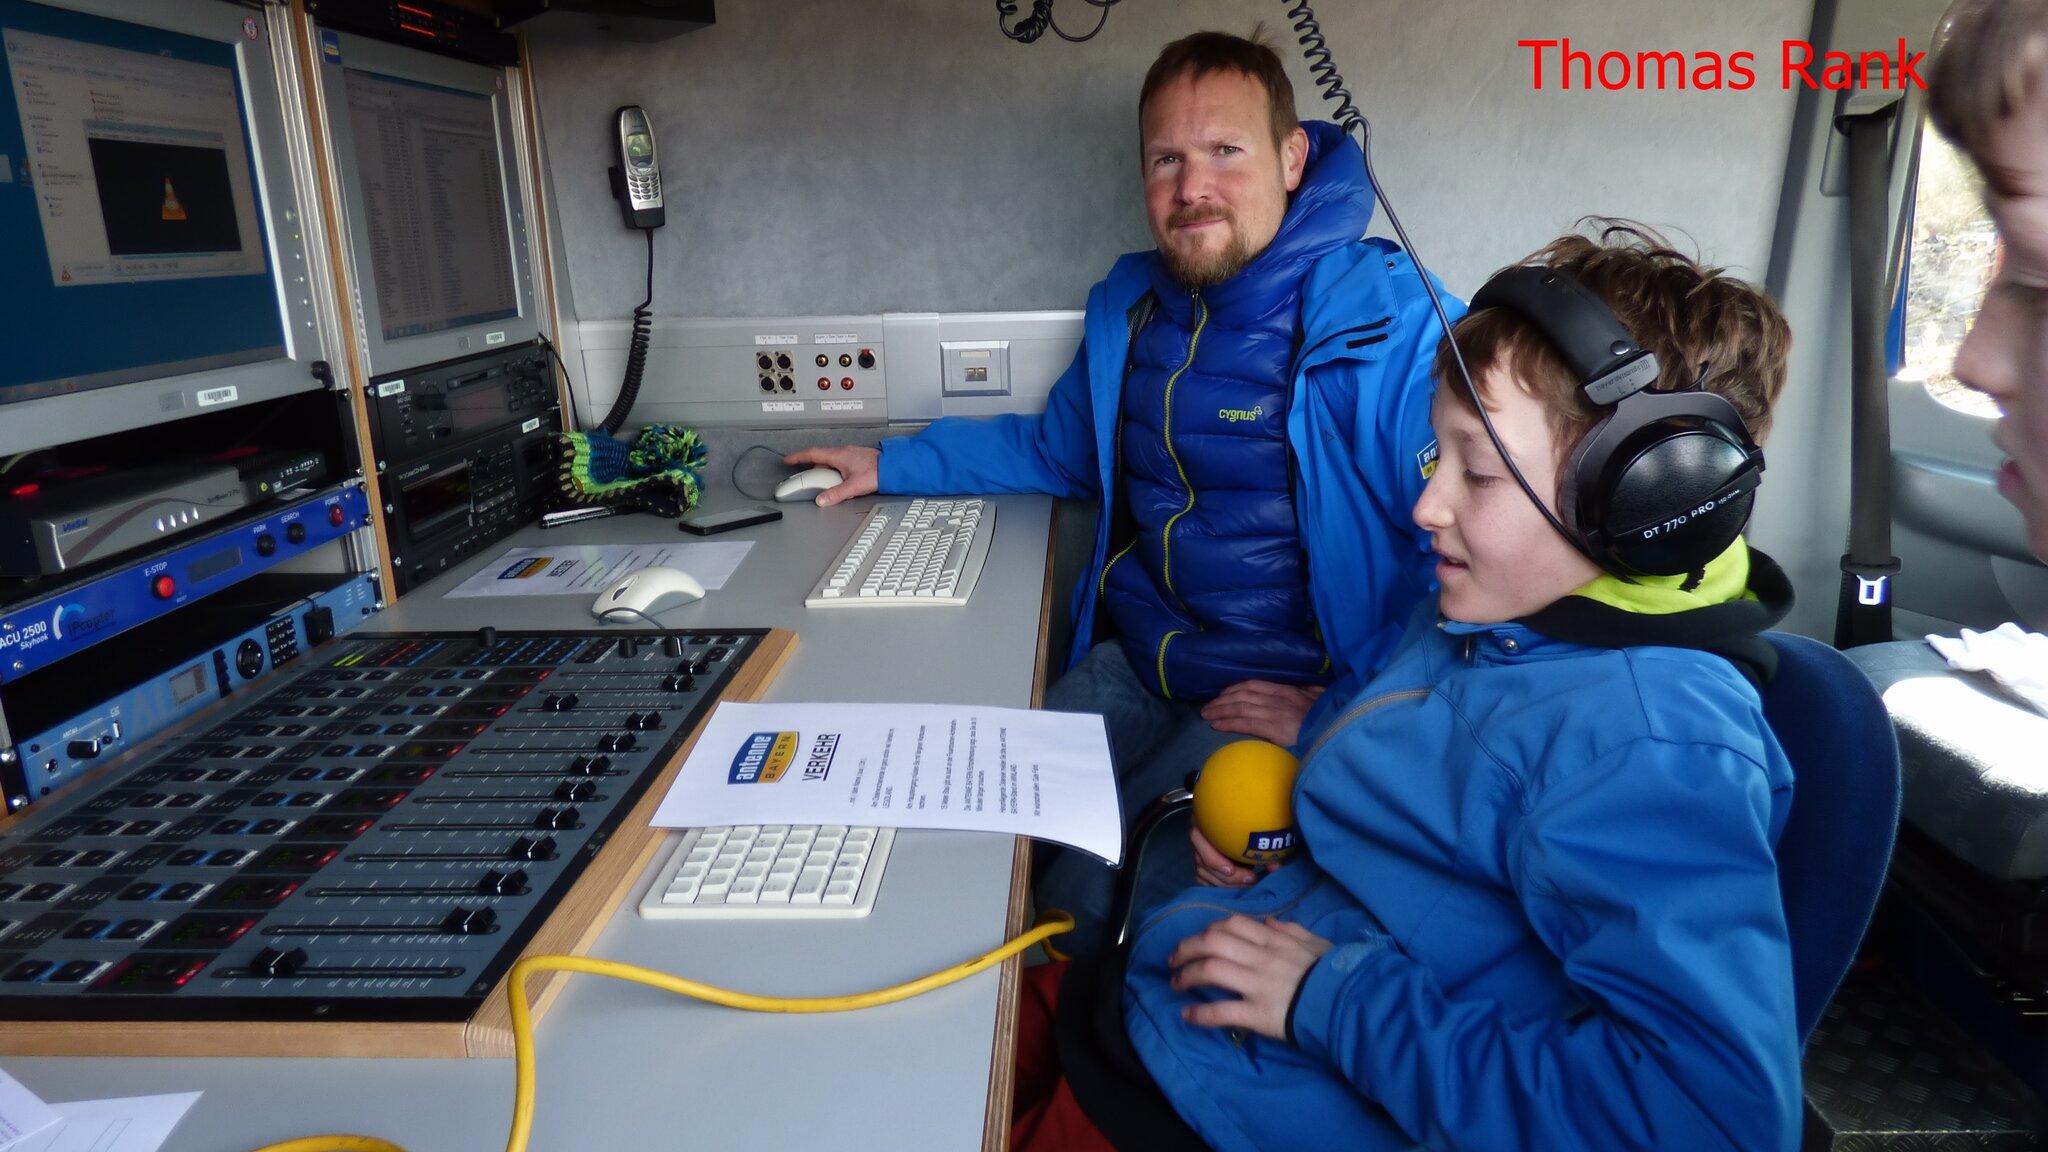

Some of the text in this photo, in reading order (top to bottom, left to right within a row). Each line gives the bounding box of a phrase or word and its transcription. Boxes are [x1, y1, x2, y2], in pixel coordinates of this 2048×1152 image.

[1423, 446, 1438, 463] an
[281, 511, 300, 524] SEARCH
[1643, 526, 1660, 539] DT
[1663, 515, 1687, 533] 770
[1691, 501, 1715, 518] PRO
[253, 525, 267, 535] PARK
[144, 561, 168, 577] E-STOP
[0, 621, 47, 649] ACU 2500
[20, 633, 49, 650] Skyhook
[737, 735, 773, 781] antenne
[765, 735, 792, 779] BAYERN
[802, 733, 837, 781] VERKEHR
[1257, 832, 1296, 851] ant
